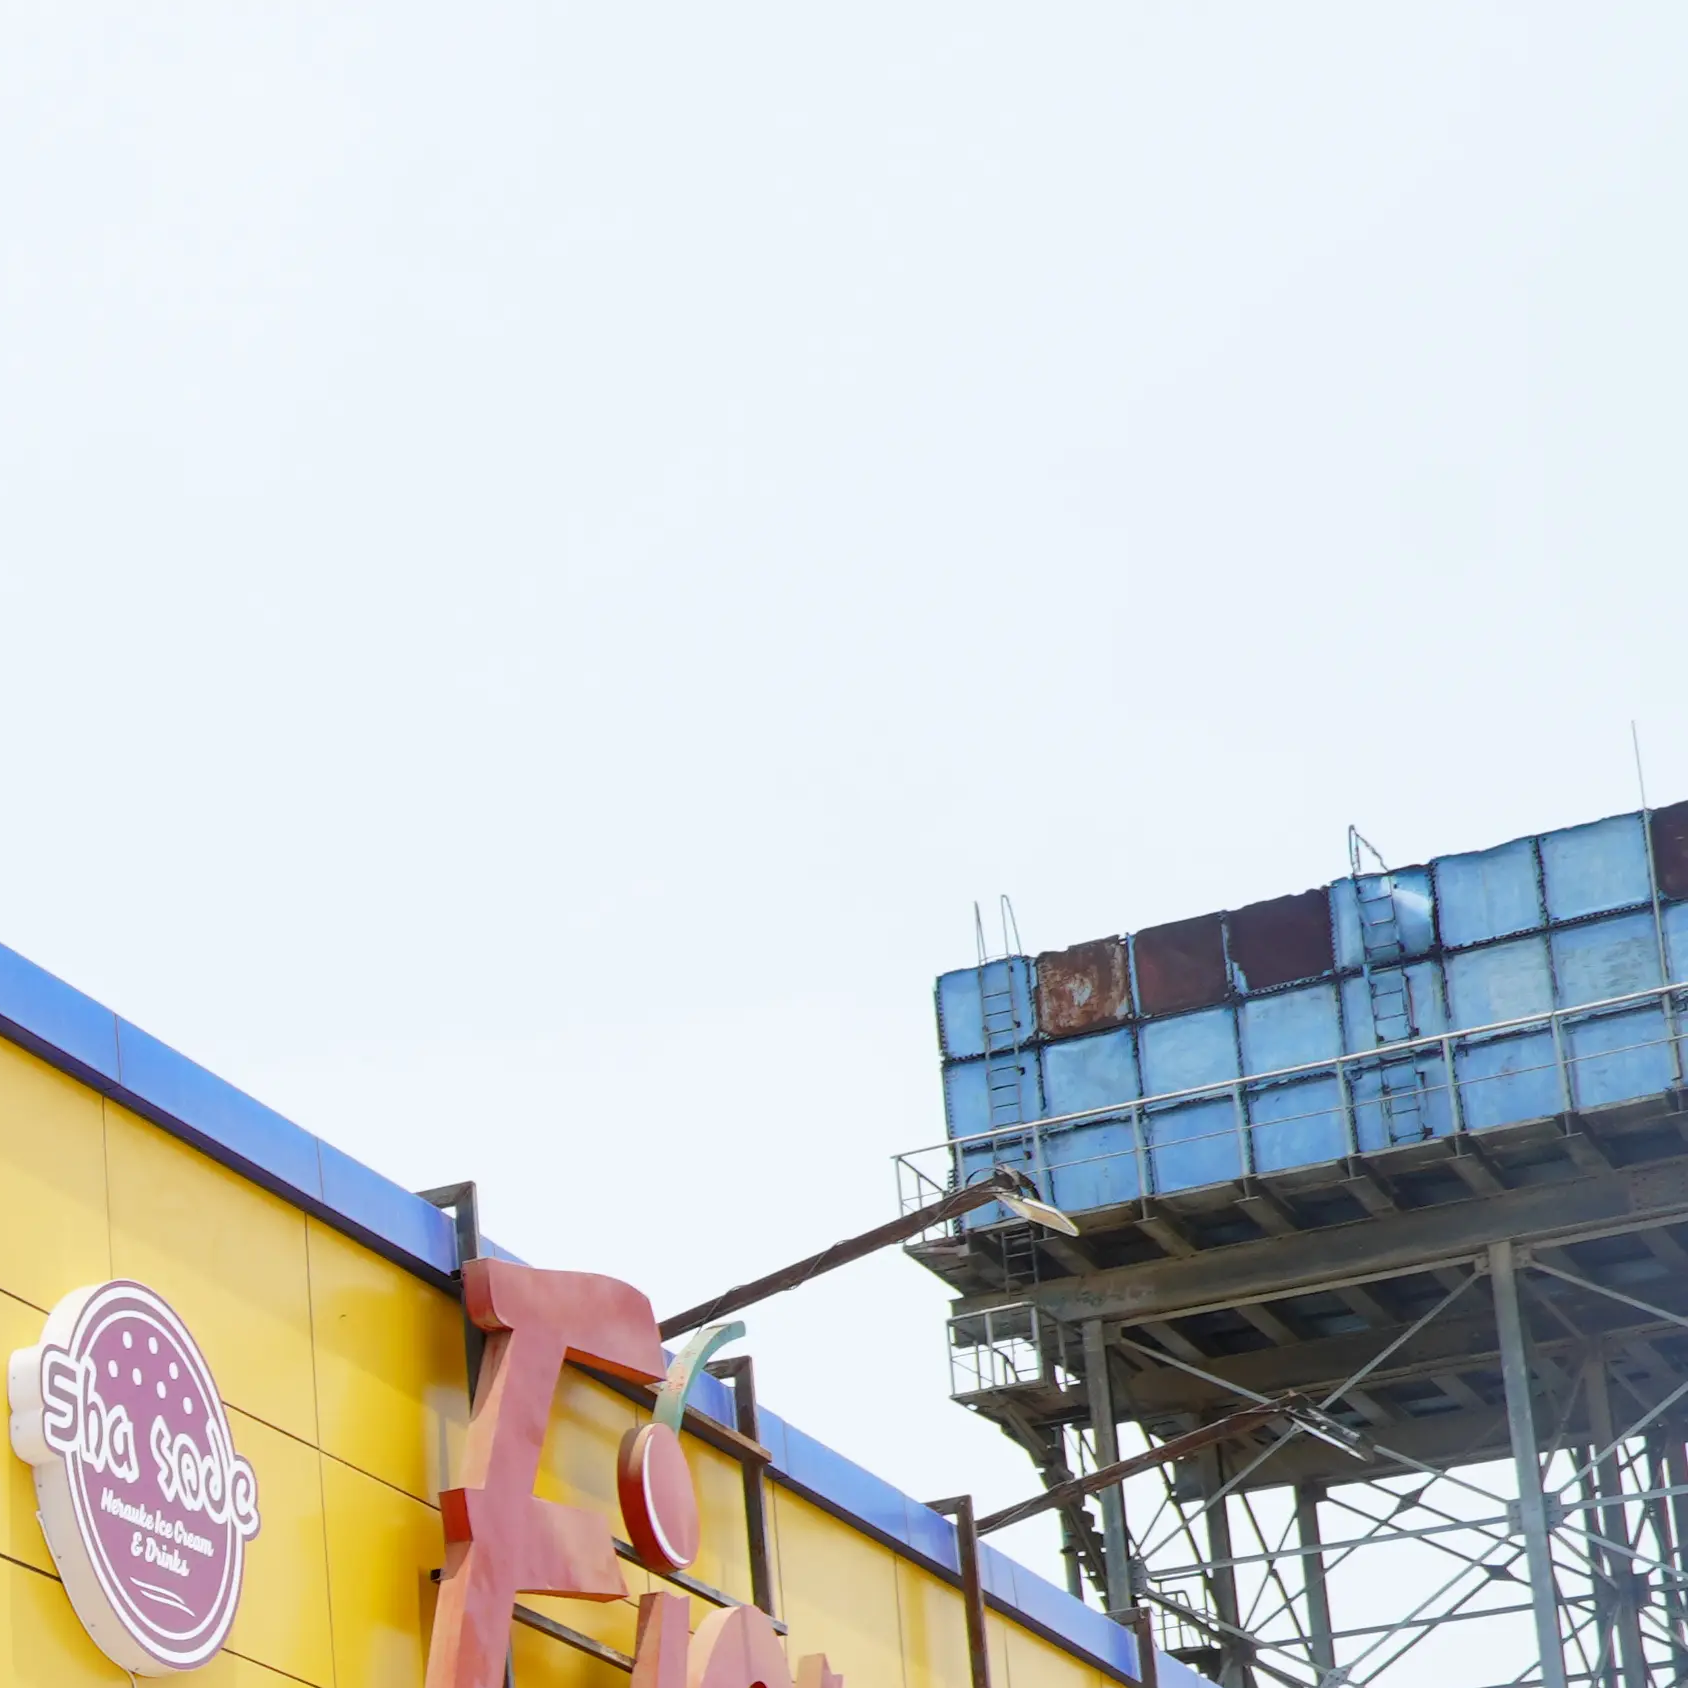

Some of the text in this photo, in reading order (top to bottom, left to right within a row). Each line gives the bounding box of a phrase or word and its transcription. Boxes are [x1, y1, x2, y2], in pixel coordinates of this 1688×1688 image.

[154, 1510, 174, 1539] Ice
[131, 1531, 190, 1577] & Drinks
